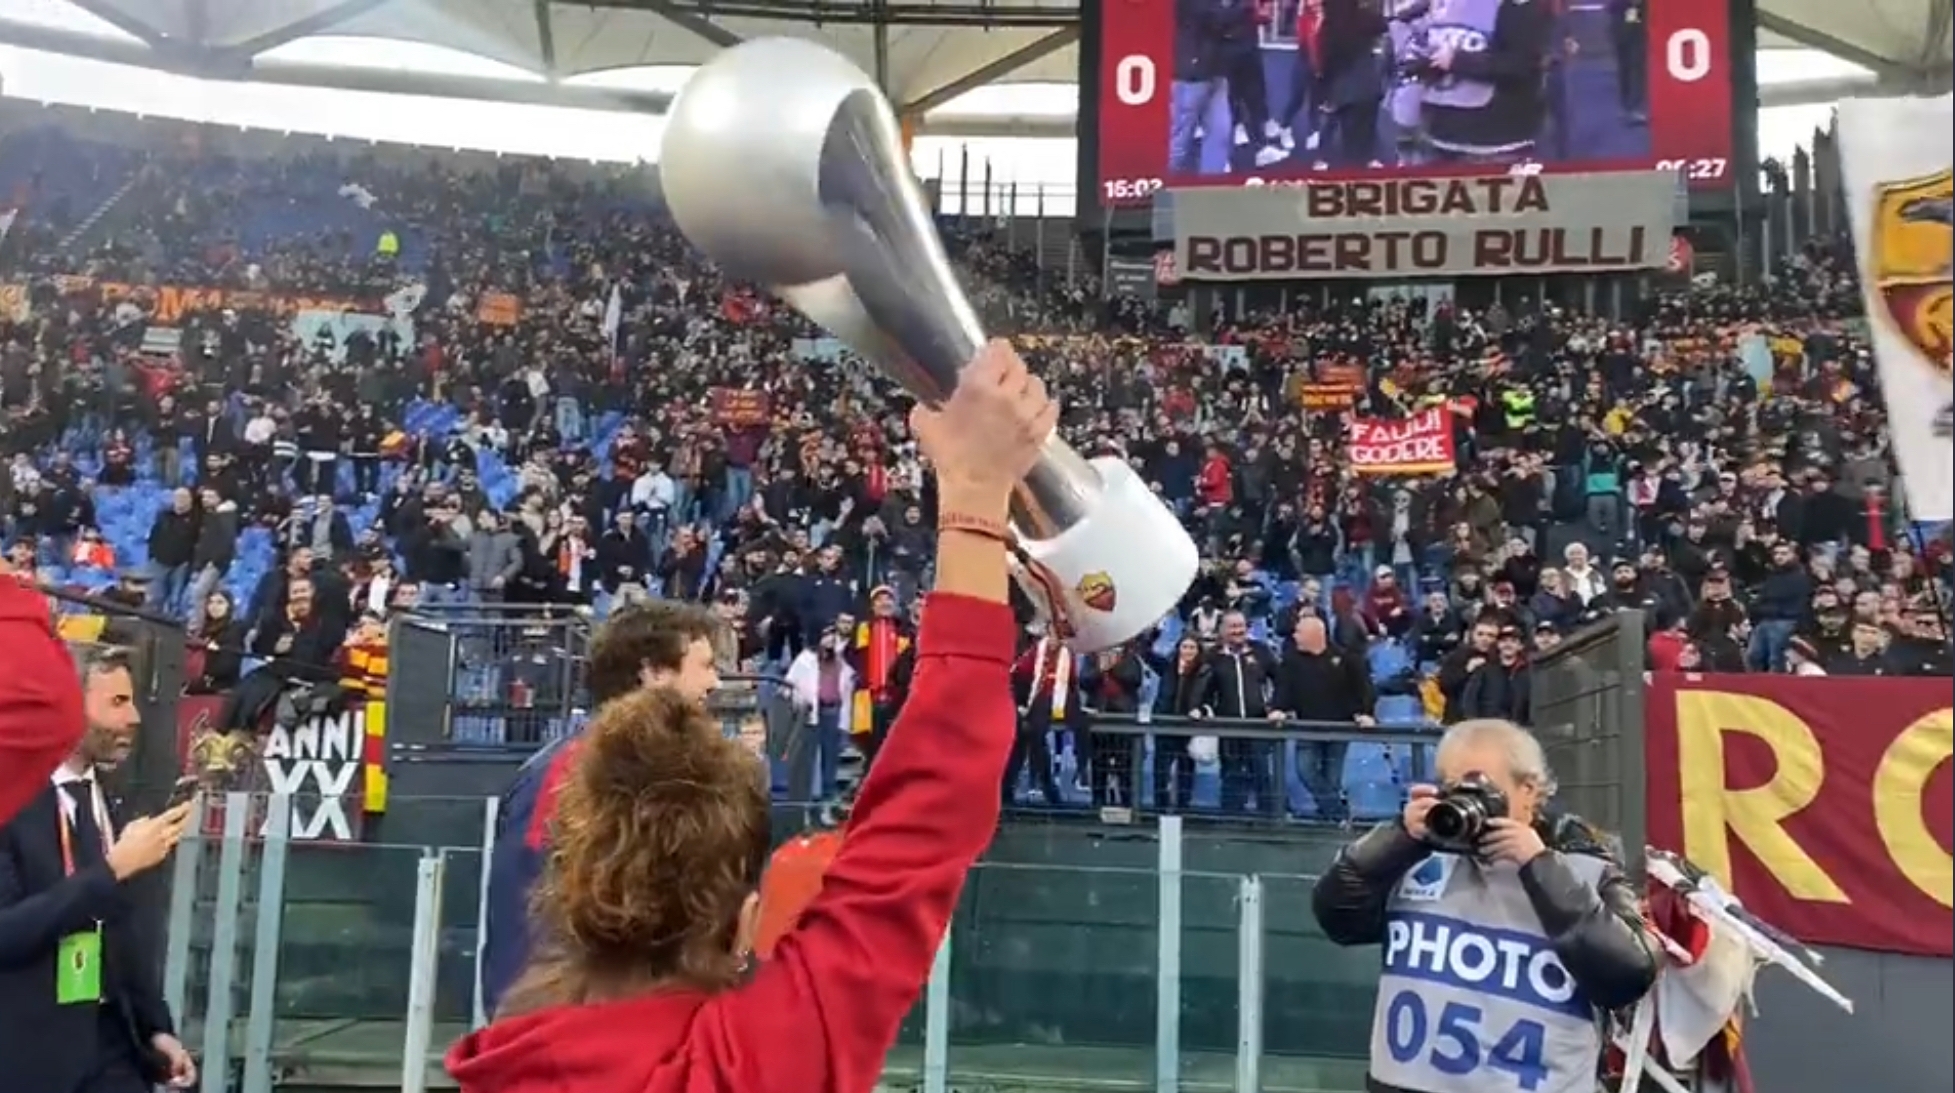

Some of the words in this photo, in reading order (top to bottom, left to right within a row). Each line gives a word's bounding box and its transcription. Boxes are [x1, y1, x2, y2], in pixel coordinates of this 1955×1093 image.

[1667, 28, 1711, 81] 0
[1116, 55, 1156, 105] 0
[1308, 176, 1549, 218] BRIGATA
[1187, 231, 1447, 273] ROBERTO
[1474, 226, 1644, 267] RULLI
[1352, 434, 1448, 463] GODERE
[263, 710, 365, 760] ANNI
[1386, 921, 1577, 1003] PHOTO
[1387, 990, 1548, 1092] 054
